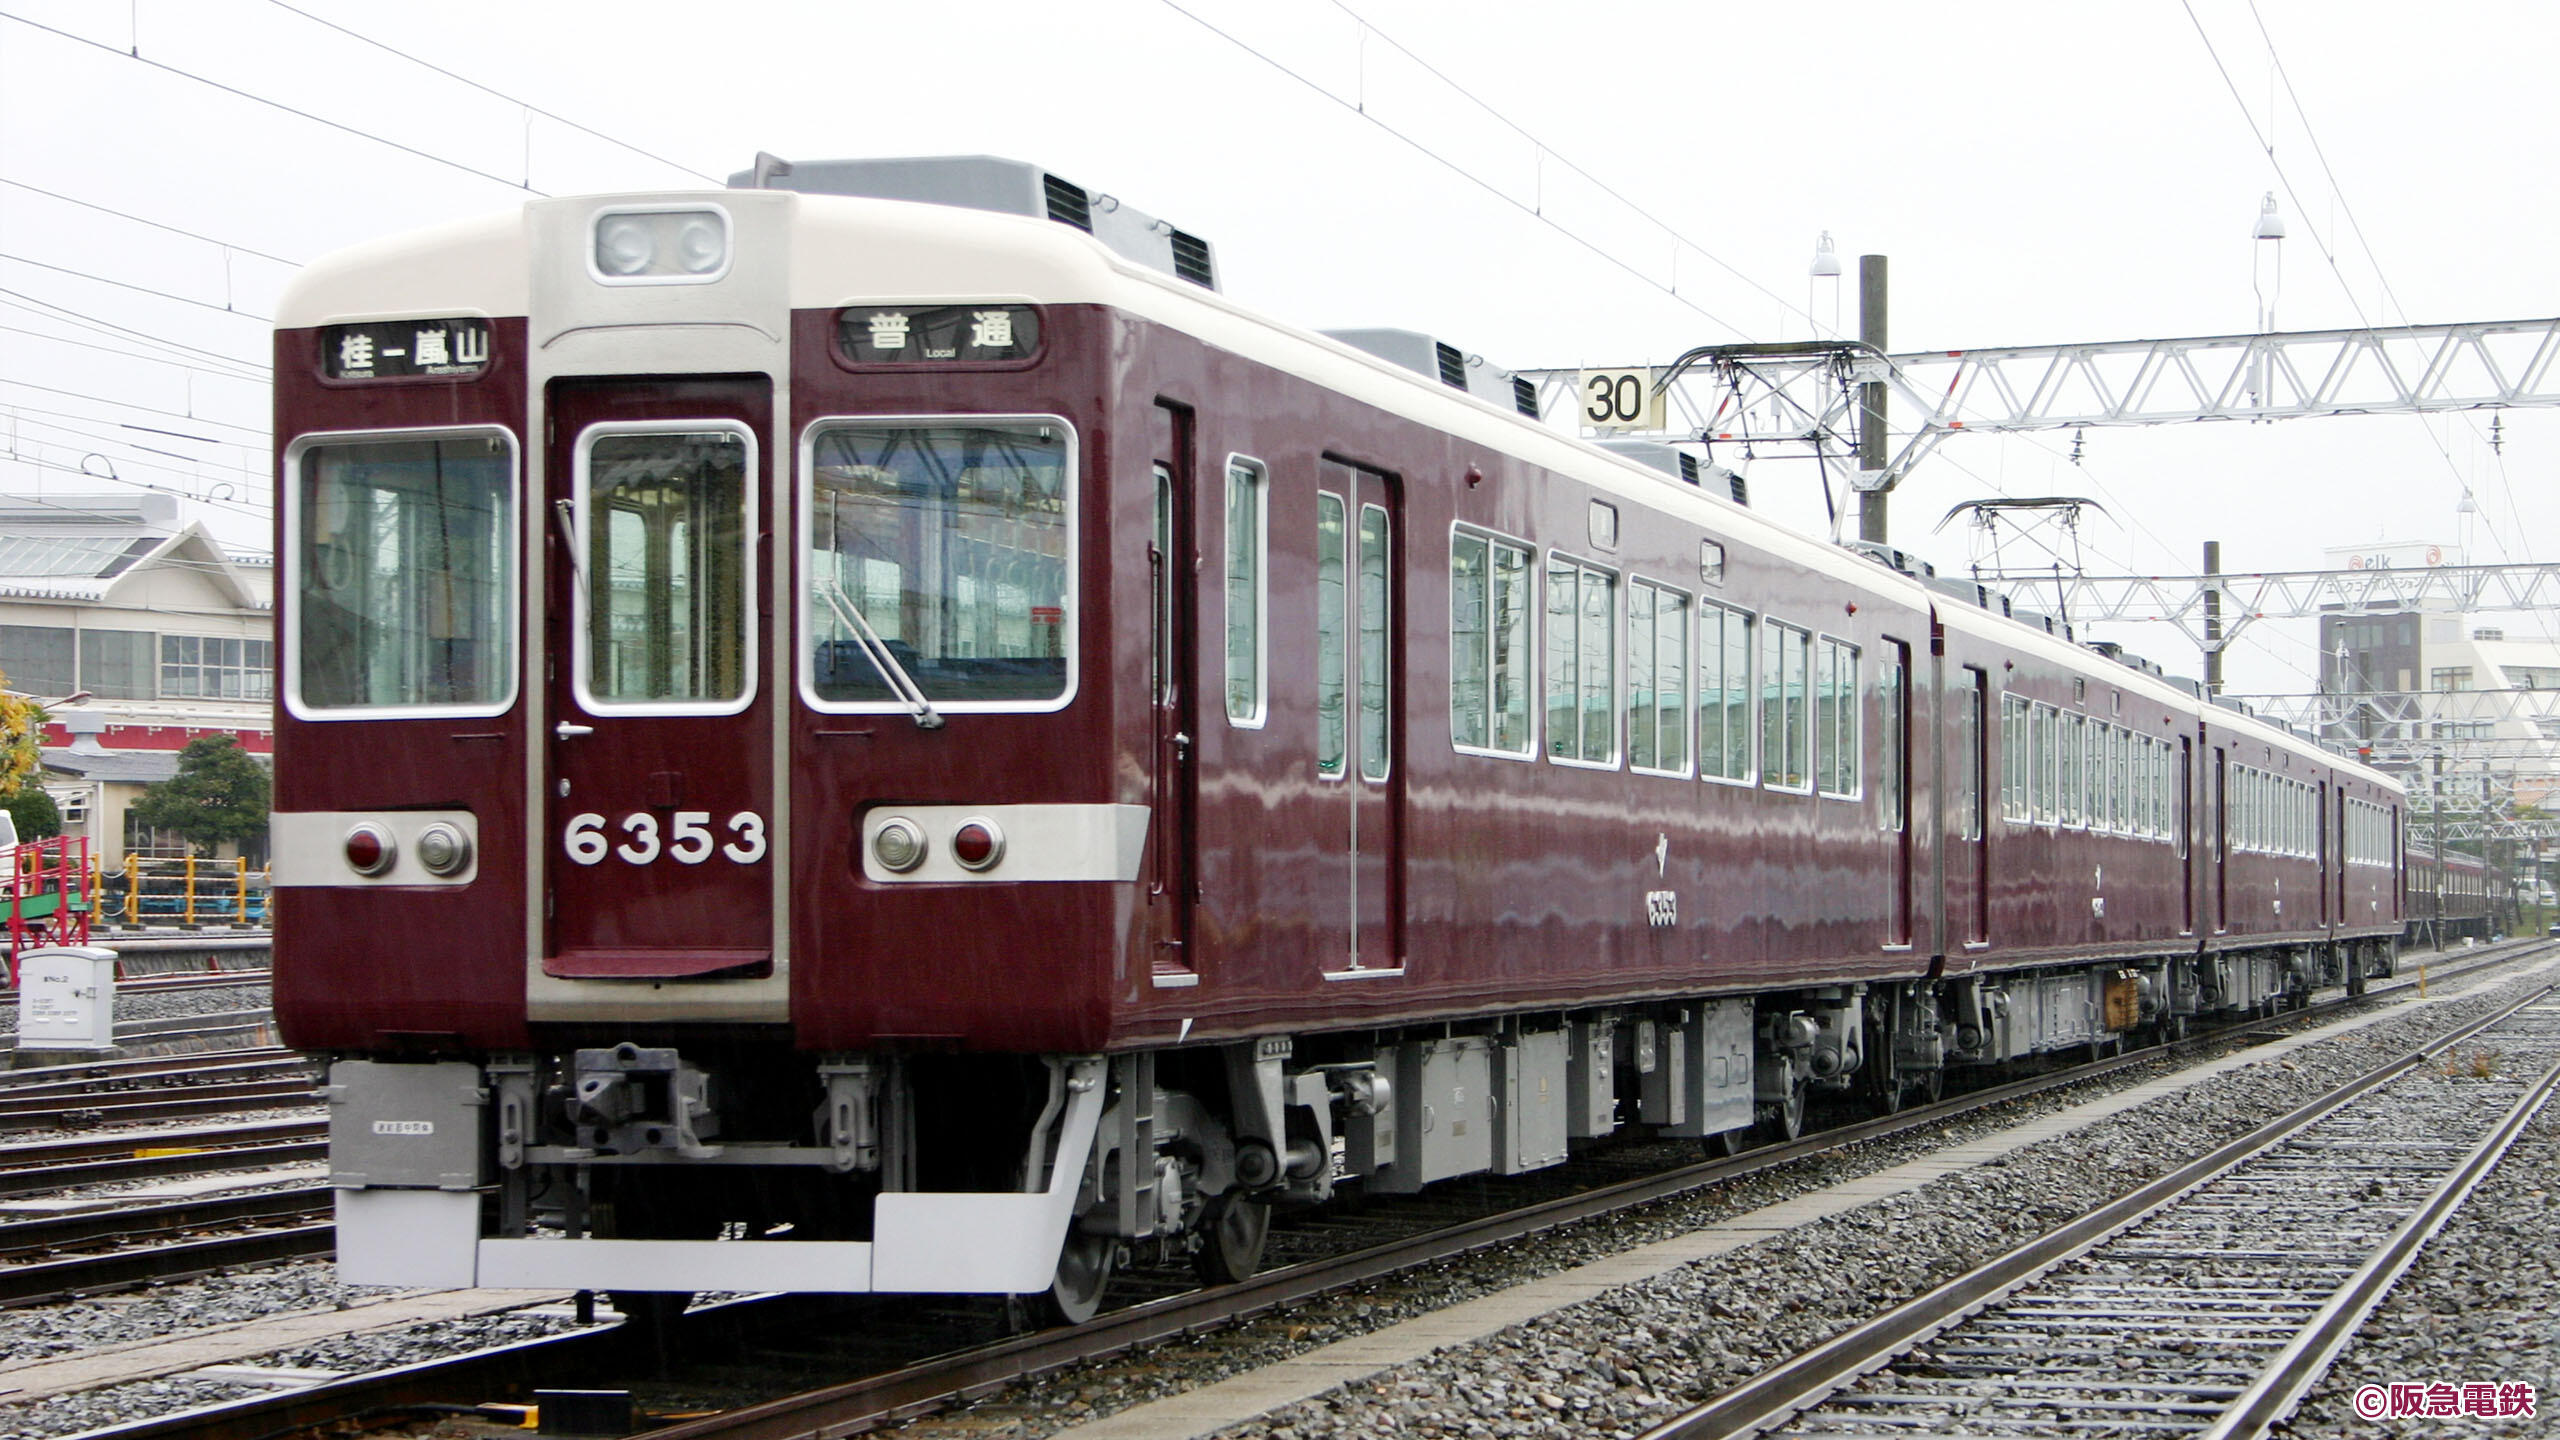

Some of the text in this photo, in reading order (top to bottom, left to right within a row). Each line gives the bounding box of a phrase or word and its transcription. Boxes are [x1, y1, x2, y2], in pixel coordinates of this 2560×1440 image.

[868, 311, 1014, 349] 普通
[926, 347, 956, 359] Local
[1587, 374, 1642, 423] 30
[564, 811, 767, 866] 6353
